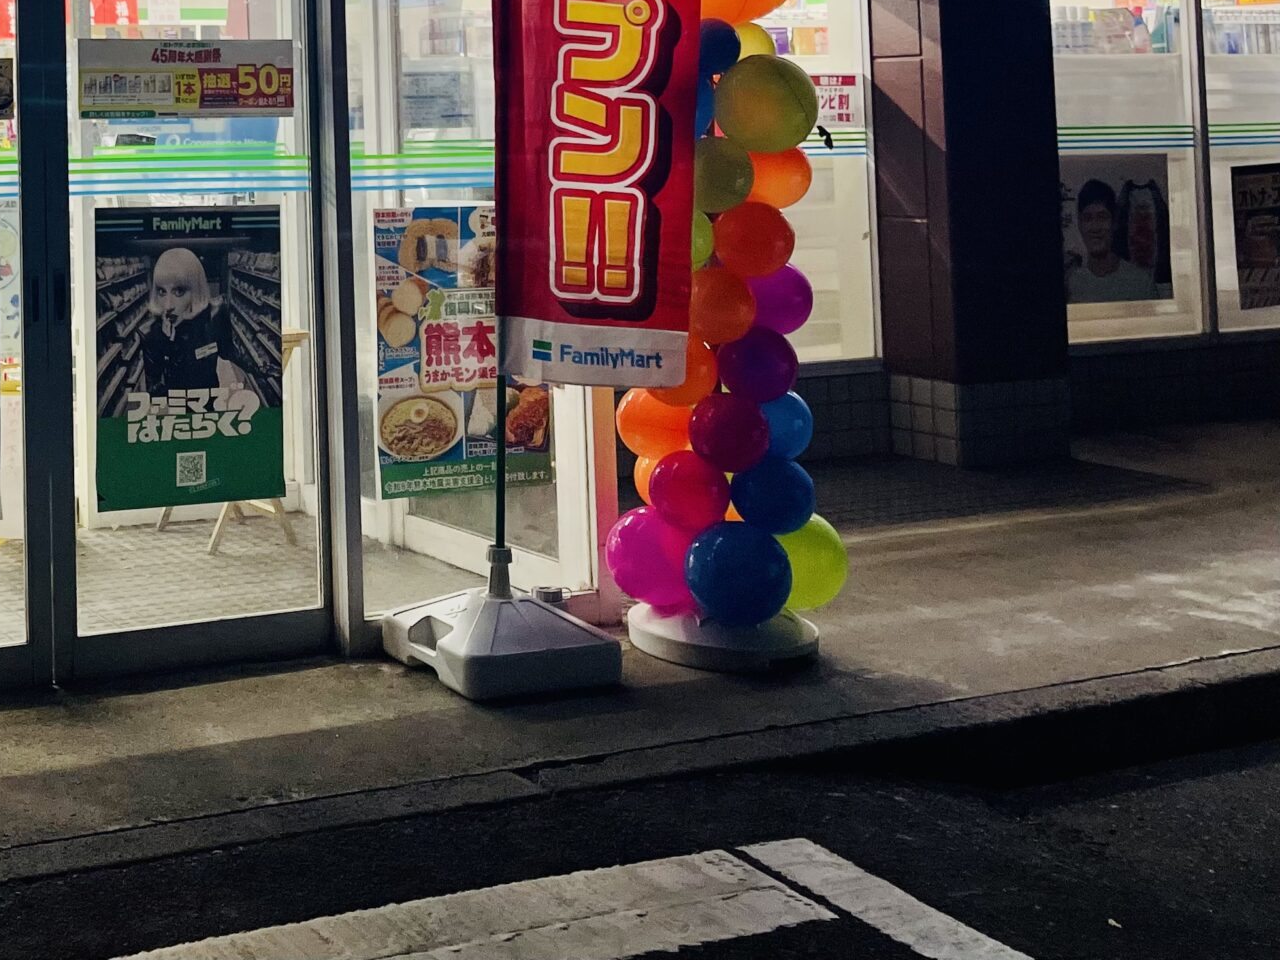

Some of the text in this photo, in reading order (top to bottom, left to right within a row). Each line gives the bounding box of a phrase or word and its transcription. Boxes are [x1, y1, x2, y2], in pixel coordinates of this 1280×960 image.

[818, 93, 850, 110] ンビ割
[153, 217, 222, 232] FamilyMart
[424, 321, 495, 367] 熊本
[558, 344, 663, 371] FamilyMart
